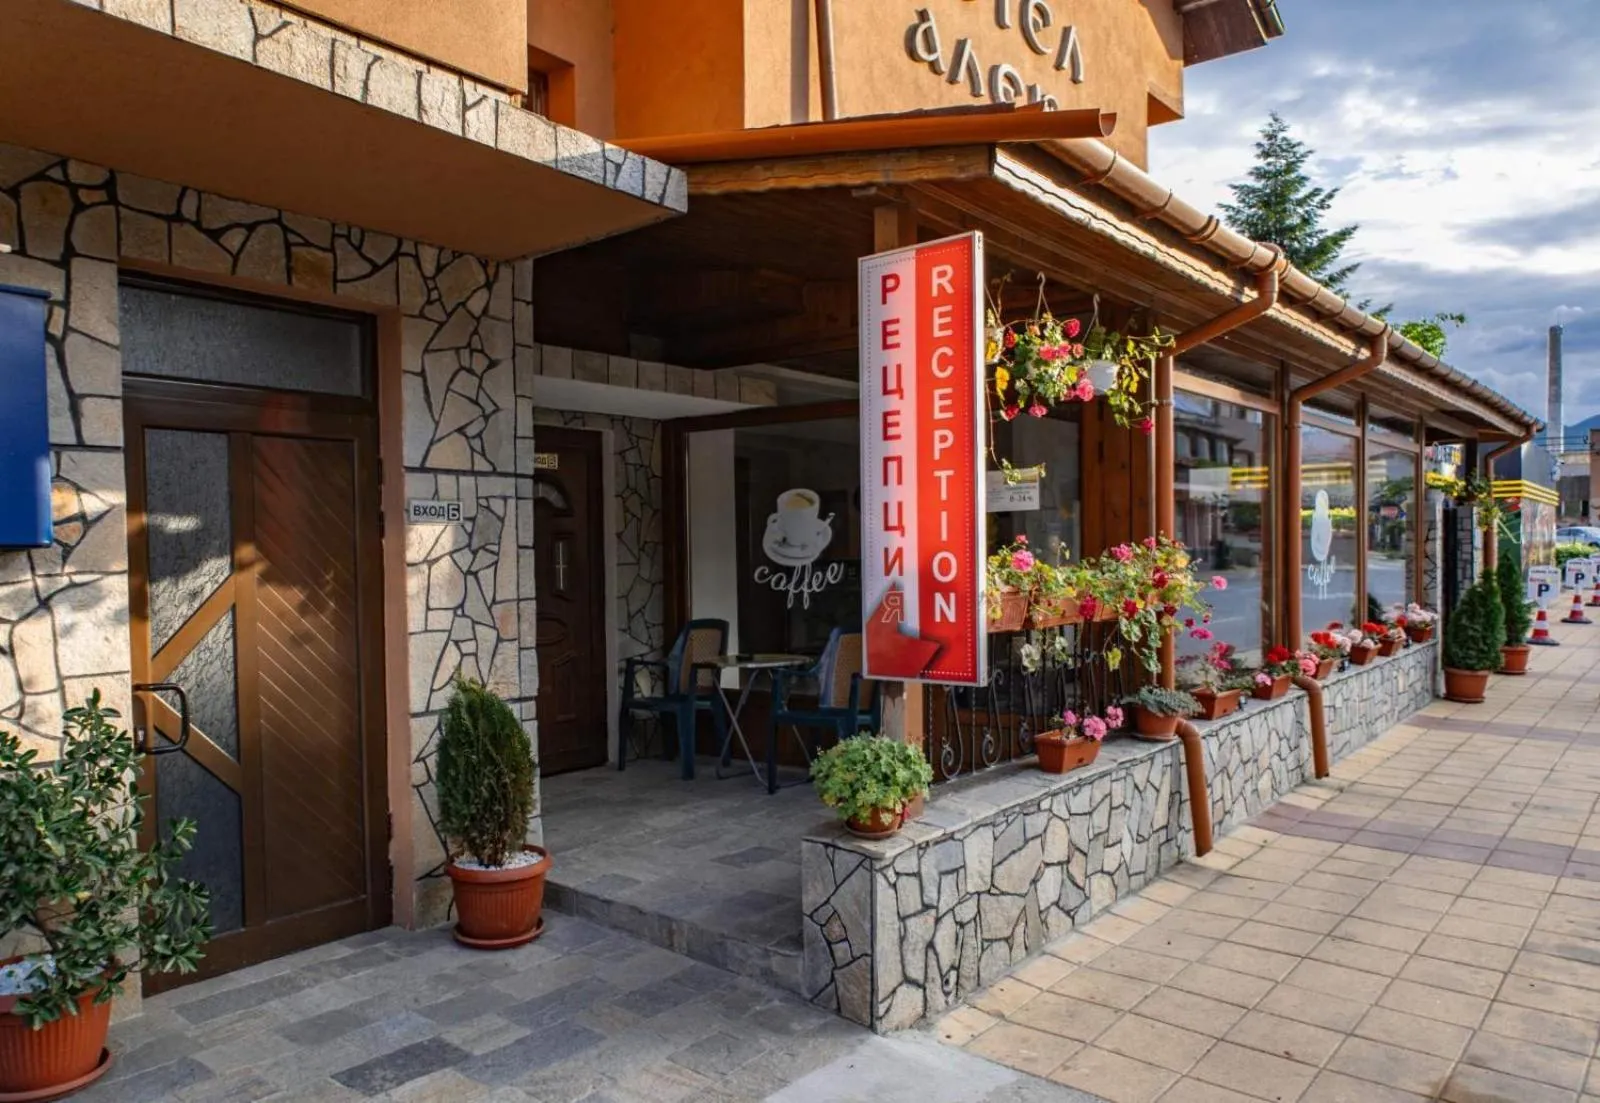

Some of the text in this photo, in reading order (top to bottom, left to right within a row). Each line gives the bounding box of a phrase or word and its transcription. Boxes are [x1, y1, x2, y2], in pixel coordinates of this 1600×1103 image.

[881, 273, 905, 623] РЕЦЕПЦИЯ
[931, 264, 958, 623] RECEPTION
[413, 503, 460, 520] ВХОД Б
[1575, 572, 1585, 584] P
[1537, 583, 1550, 597] P
